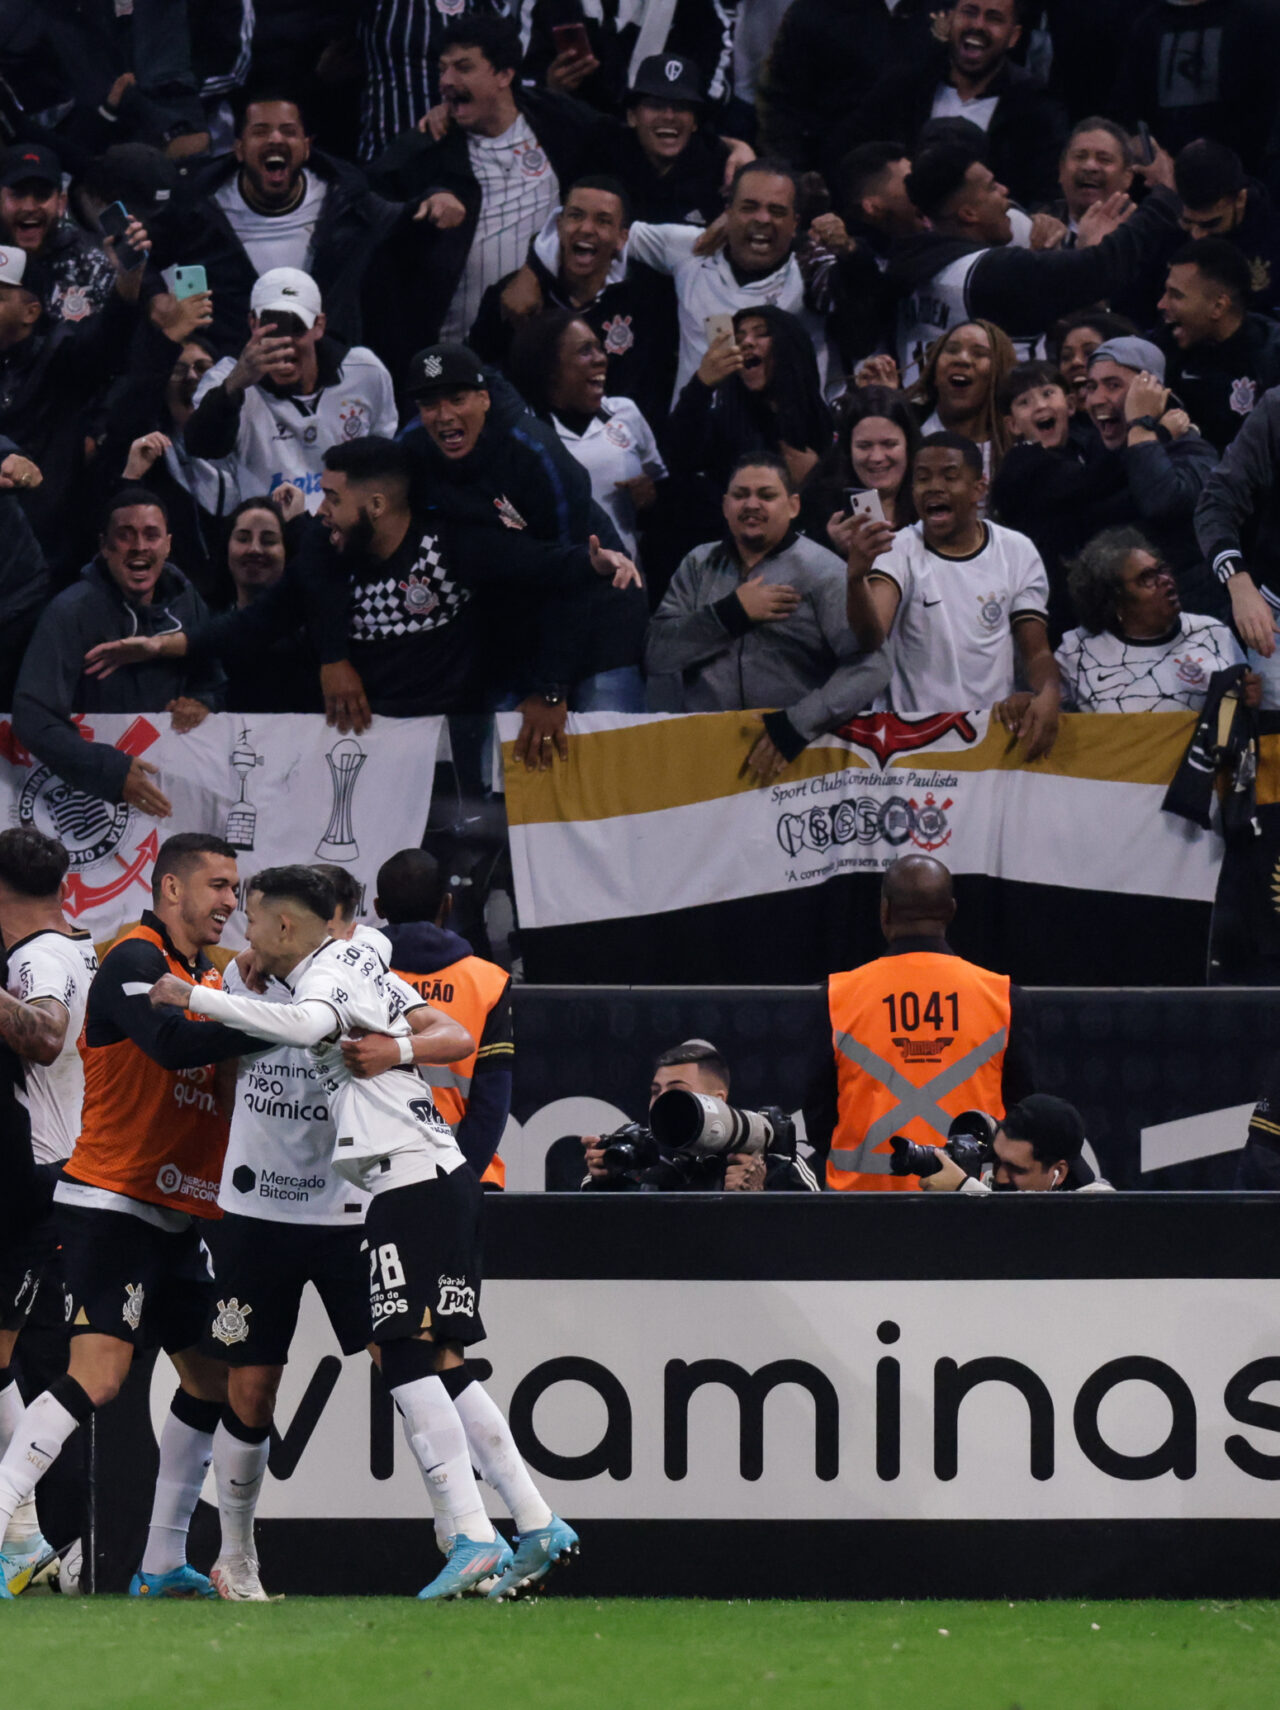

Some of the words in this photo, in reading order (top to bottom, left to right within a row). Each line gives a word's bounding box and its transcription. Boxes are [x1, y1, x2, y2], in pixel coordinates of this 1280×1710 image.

[771, 785, 807, 806] Sport
[810, 774, 843, 795] Club
[906, 771, 958, 788] Paulista
[882, 991, 959, 1033] 1041
[248, 1075, 284, 1096] neo
[244, 1092, 329, 1122] química
[261, 1169, 326, 1189] Mercado
[260, 1184, 309, 1202] Bitcoin
[387, 1290, 399, 1300] de
[372, 1298, 408, 1318] DOS
